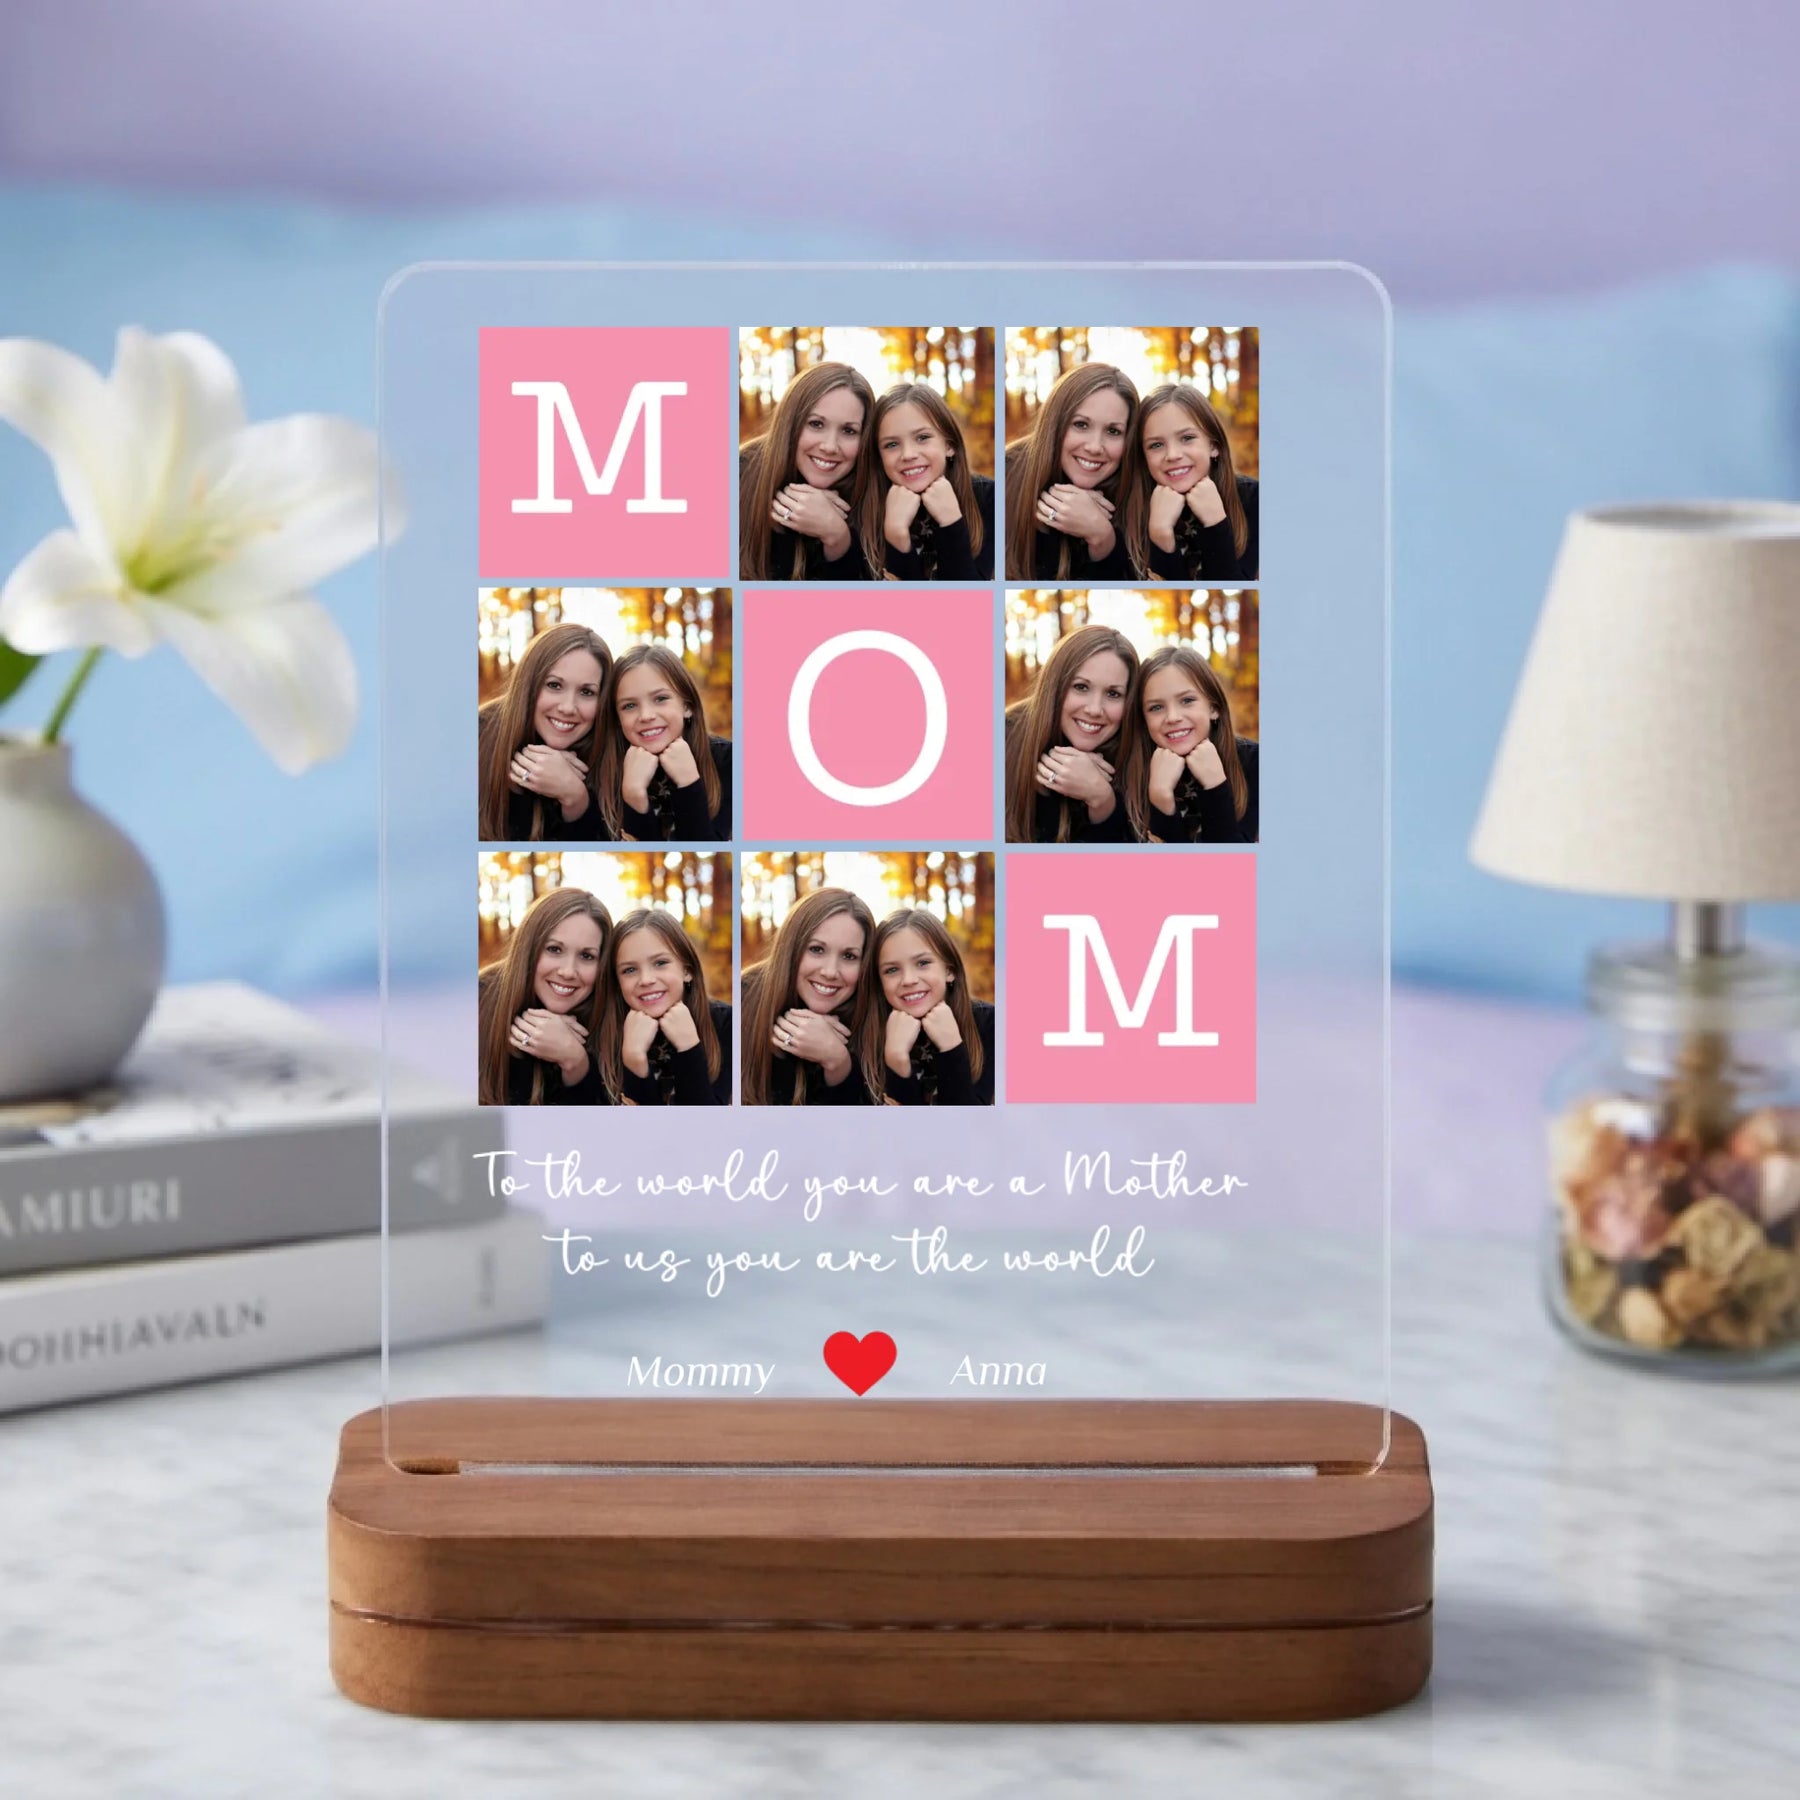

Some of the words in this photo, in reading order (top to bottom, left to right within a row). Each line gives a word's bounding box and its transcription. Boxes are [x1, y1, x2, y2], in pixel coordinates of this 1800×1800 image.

[512, 382, 687, 512] M
[788, 630, 948, 806] O
[1043, 914, 1219, 1046] M
[473, 1150, 528, 1197] To
[524, 1150, 621, 1199] the
[637, 1149, 788, 1201] world
[803, 1175, 898, 1222] you
[913, 1175, 993, 1197] are
[1009, 1175, 1046, 1197] a
[1064, 1149, 1248, 1200] Mother
[542, 1228, 609, 1276] to
[624, 1249, 691, 1283] us
[706, 1251, 801, 1298] you
[816, 1250, 896, 1272] are
[891, 1225, 988, 1276] the
[1003, 1224, 1155, 1278] world
[626, 1355, 775, 1395] Mommy
[949, 1354, 1047, 1386] Anna
